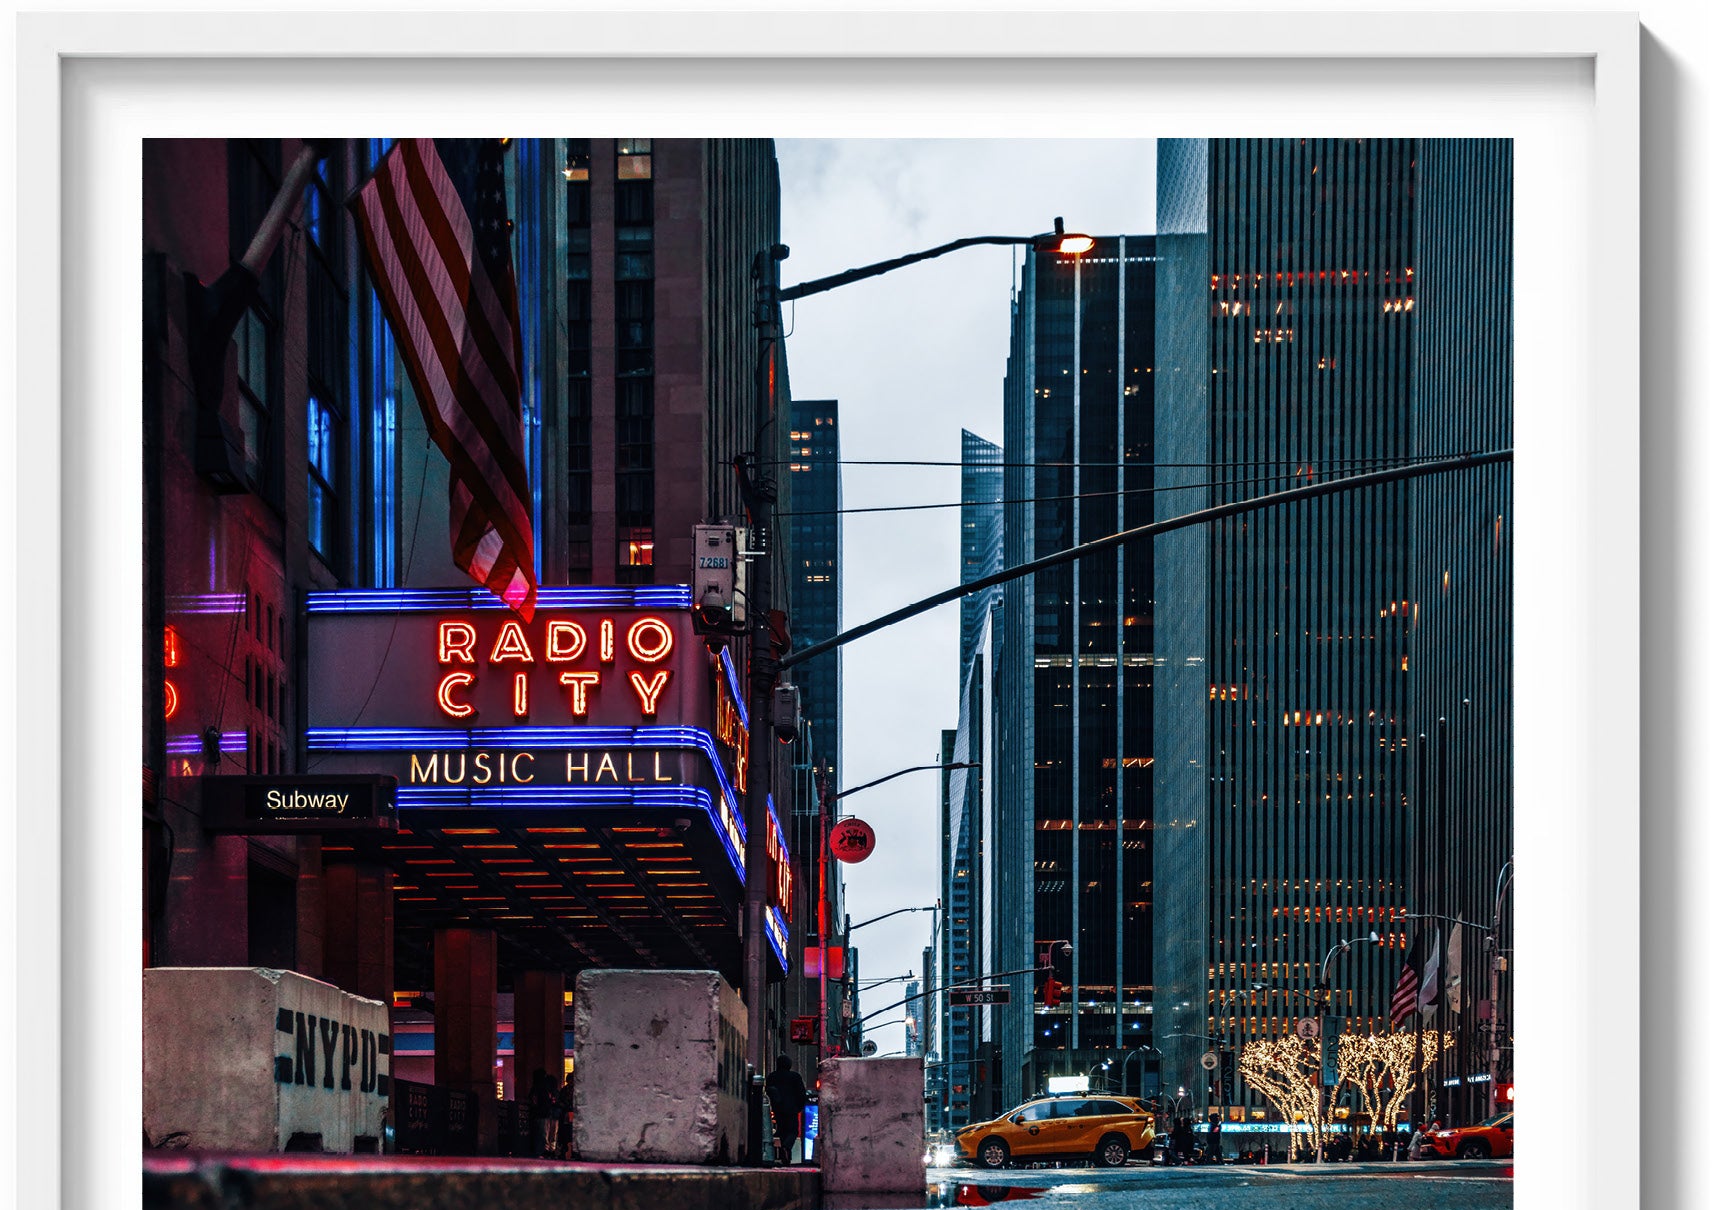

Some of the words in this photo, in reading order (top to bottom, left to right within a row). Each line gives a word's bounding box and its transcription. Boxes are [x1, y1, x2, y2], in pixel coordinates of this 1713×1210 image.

[700, 557, 728, 569] 72681
[437, 617, 674, 664] RADIO
[437, 669, 672, 718] CITY
[410, 752, 535, 784] MUSIC
[566, 752, 673, 783] HALL
[266, 790, 349, 814] Subway
[965, 994, 972, 1002] W
[974, 993, 984, 1002] 50
[986, 993, 994, 1001] St
[294, 1011, 377, 1093] NYPD
